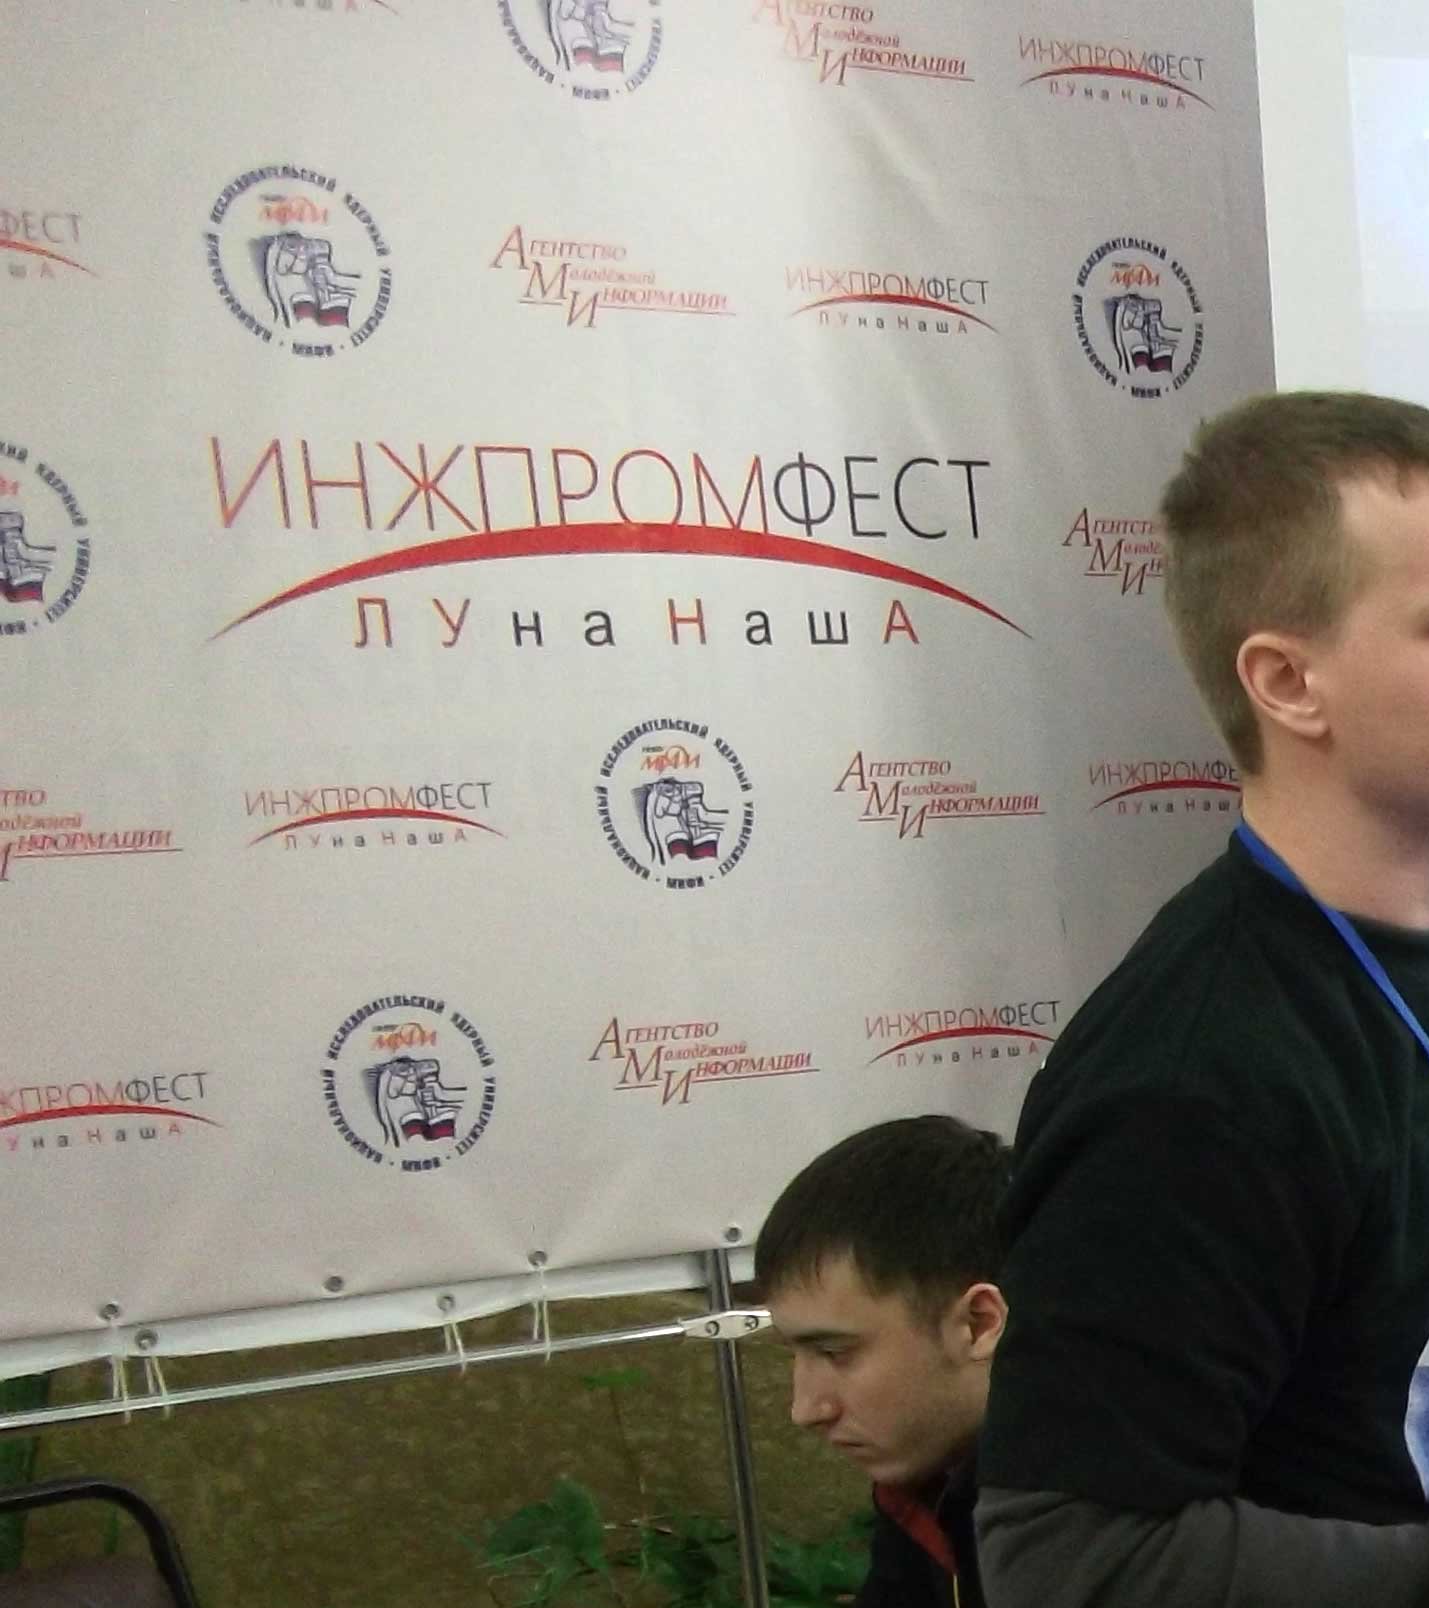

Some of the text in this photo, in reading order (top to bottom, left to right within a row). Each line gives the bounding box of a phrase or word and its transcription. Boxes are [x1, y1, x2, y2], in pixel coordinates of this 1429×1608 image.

[1018, 33, 1209, 80] ИНЖПРОМФЕСТ
[784, 265, 989, 304] ИНЖПРОМФЕСТ
[211, 436, 991, 539] ИНЖПРОМФЕСТ
[834, 751, 951, 792] АГЕНТСТВО
[1088, 759, 1239, 786] ИНЖПРОМФЕ
[245, 782, 492, 816] ИНЖПРОМФЕСТ
[1185, 798, 1242, 813] Наш
[588, 1017, 719, 1061] АГЕНТСТВО
[865, 1001, 1060, 1039] ИНЖПРОМФЕСТ
